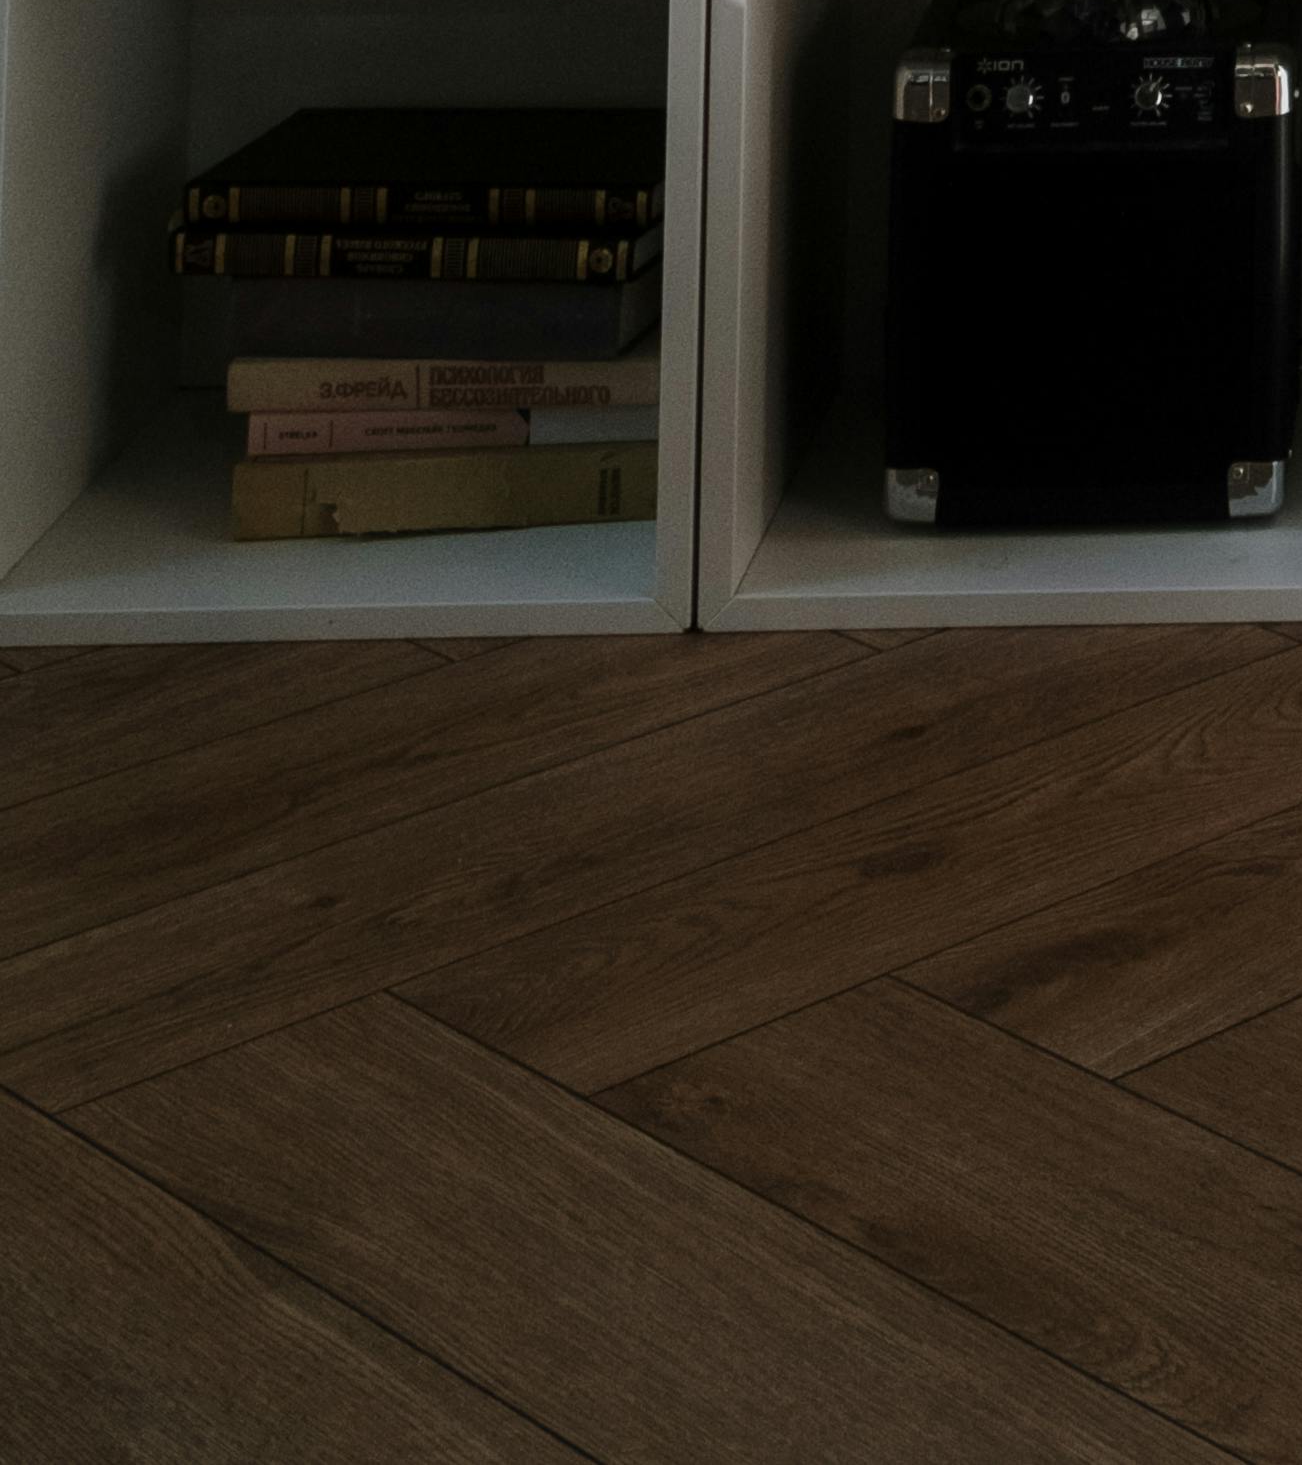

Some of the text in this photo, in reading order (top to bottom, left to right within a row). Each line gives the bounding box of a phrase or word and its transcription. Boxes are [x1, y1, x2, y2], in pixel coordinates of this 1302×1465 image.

[428, 365, 545, 385] ПСИХОЛОГИЯ
[319, 380, 408, 401] З.ФРЕЙД
[429, 385, 611, 407] БЕССОЗНАТЕЛЬНОГО
